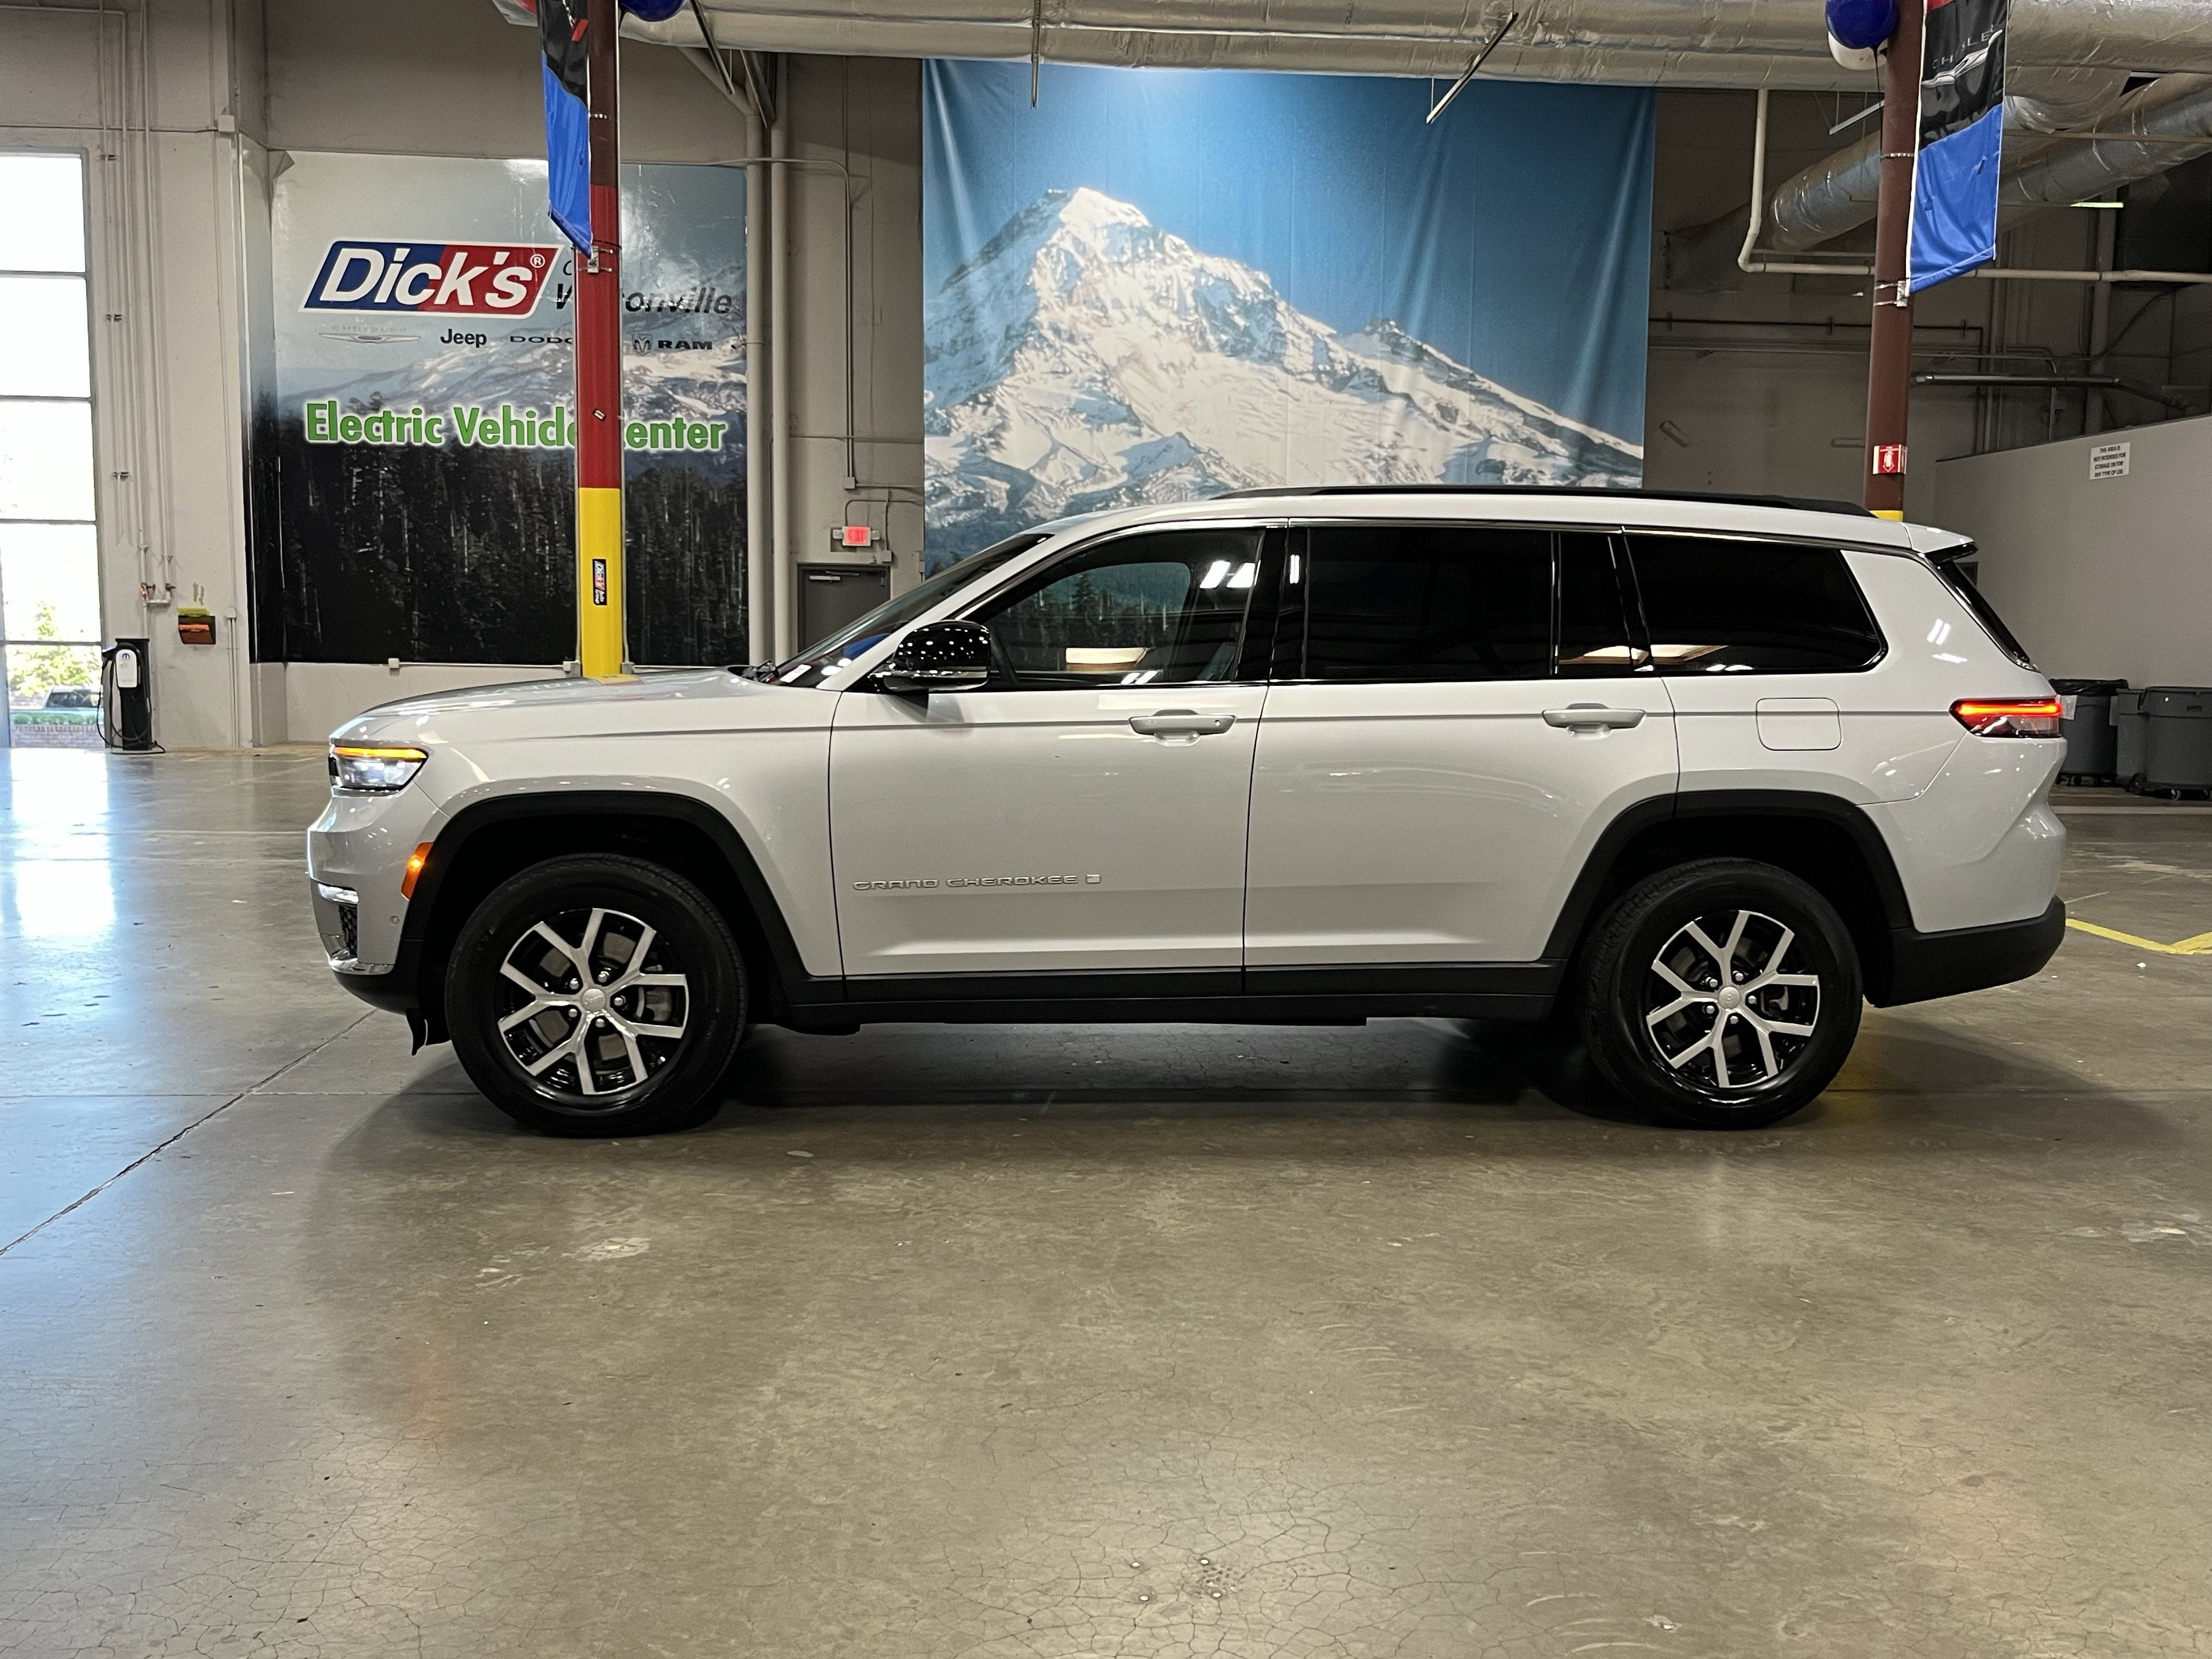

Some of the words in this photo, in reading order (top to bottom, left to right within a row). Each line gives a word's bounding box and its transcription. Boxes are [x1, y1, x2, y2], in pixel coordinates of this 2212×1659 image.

[319, 247, 533, 308] Dick's
[440, 328, 487, 348] Jeep
[658, 340, 713, 350] RAM
[307, 400, 443, 444] Electric
[626, 417, 726, 449] enter
[853, 879, 939, 891] GRAND
[946, 874, 1079, 888] CHEROKEE
